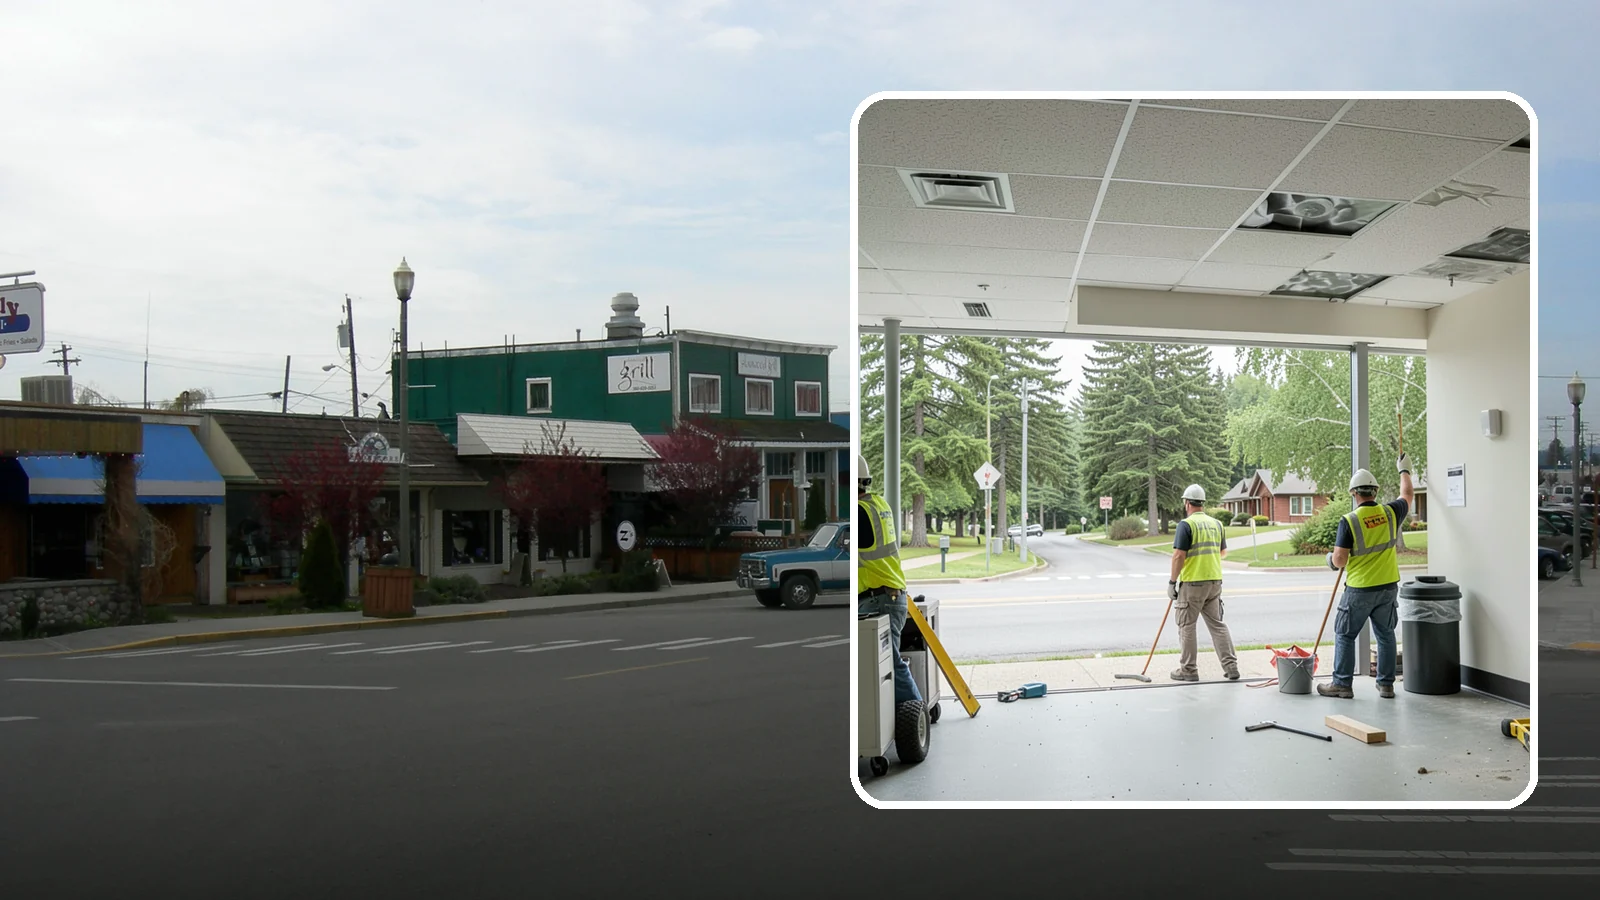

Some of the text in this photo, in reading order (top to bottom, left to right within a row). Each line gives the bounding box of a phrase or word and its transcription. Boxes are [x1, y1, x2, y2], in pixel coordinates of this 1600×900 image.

[3, 337, 38, 346] Fries Salads
[618, 355, 655, 391] grill
